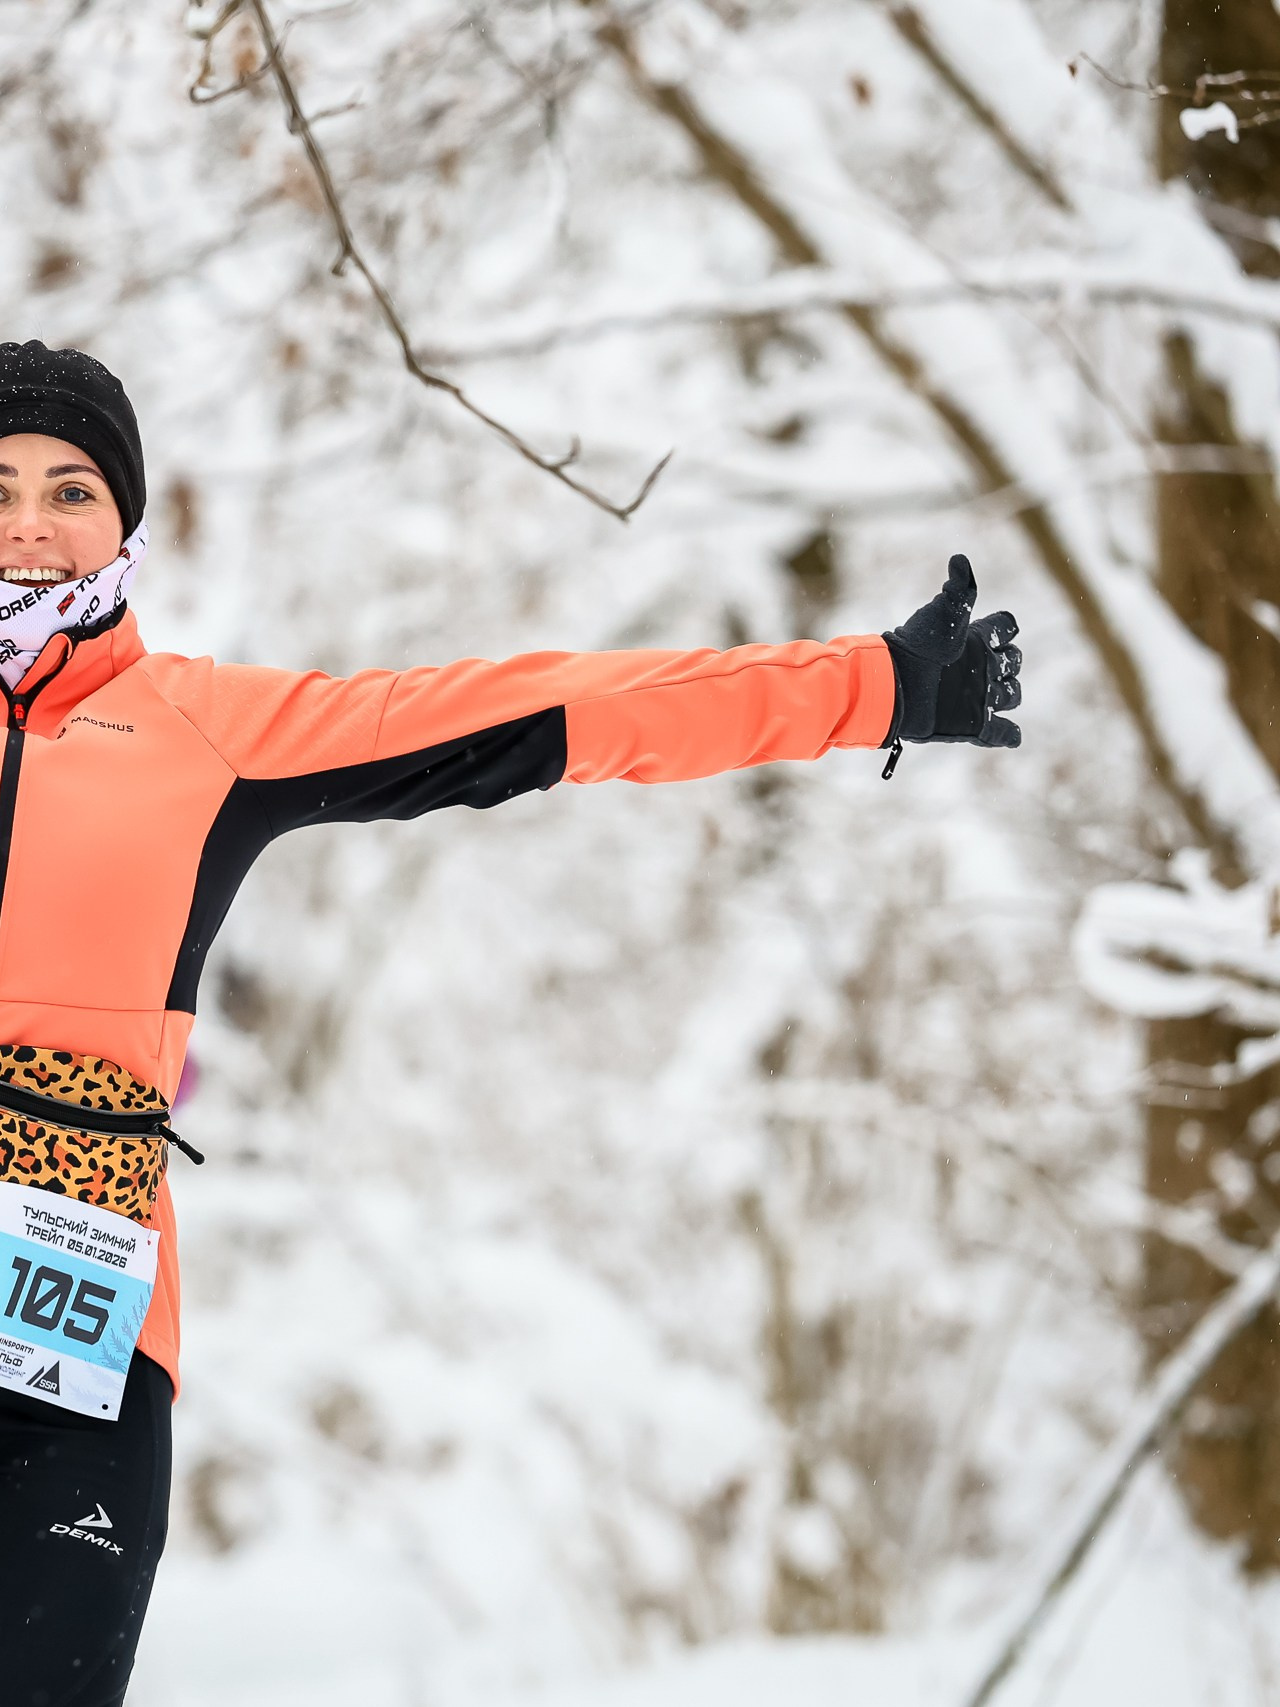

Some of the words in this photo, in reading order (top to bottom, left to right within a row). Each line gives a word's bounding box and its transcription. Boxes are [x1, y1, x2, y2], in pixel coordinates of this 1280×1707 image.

[23, 1205, 89, 1237] ТУЛЬСКИЙ
[90, 1228, 137, 1254] ЗИМНИЙ
[25, 1223, 64, 1247] ТРЕЙЛ
[66, 1238, 128, 1269] 05.01.2026
[4, 1256, 117, 1345] 105
[39, 1379, 57, 1392] SSR
[49, 1523, 124, 1556] DEMIX
